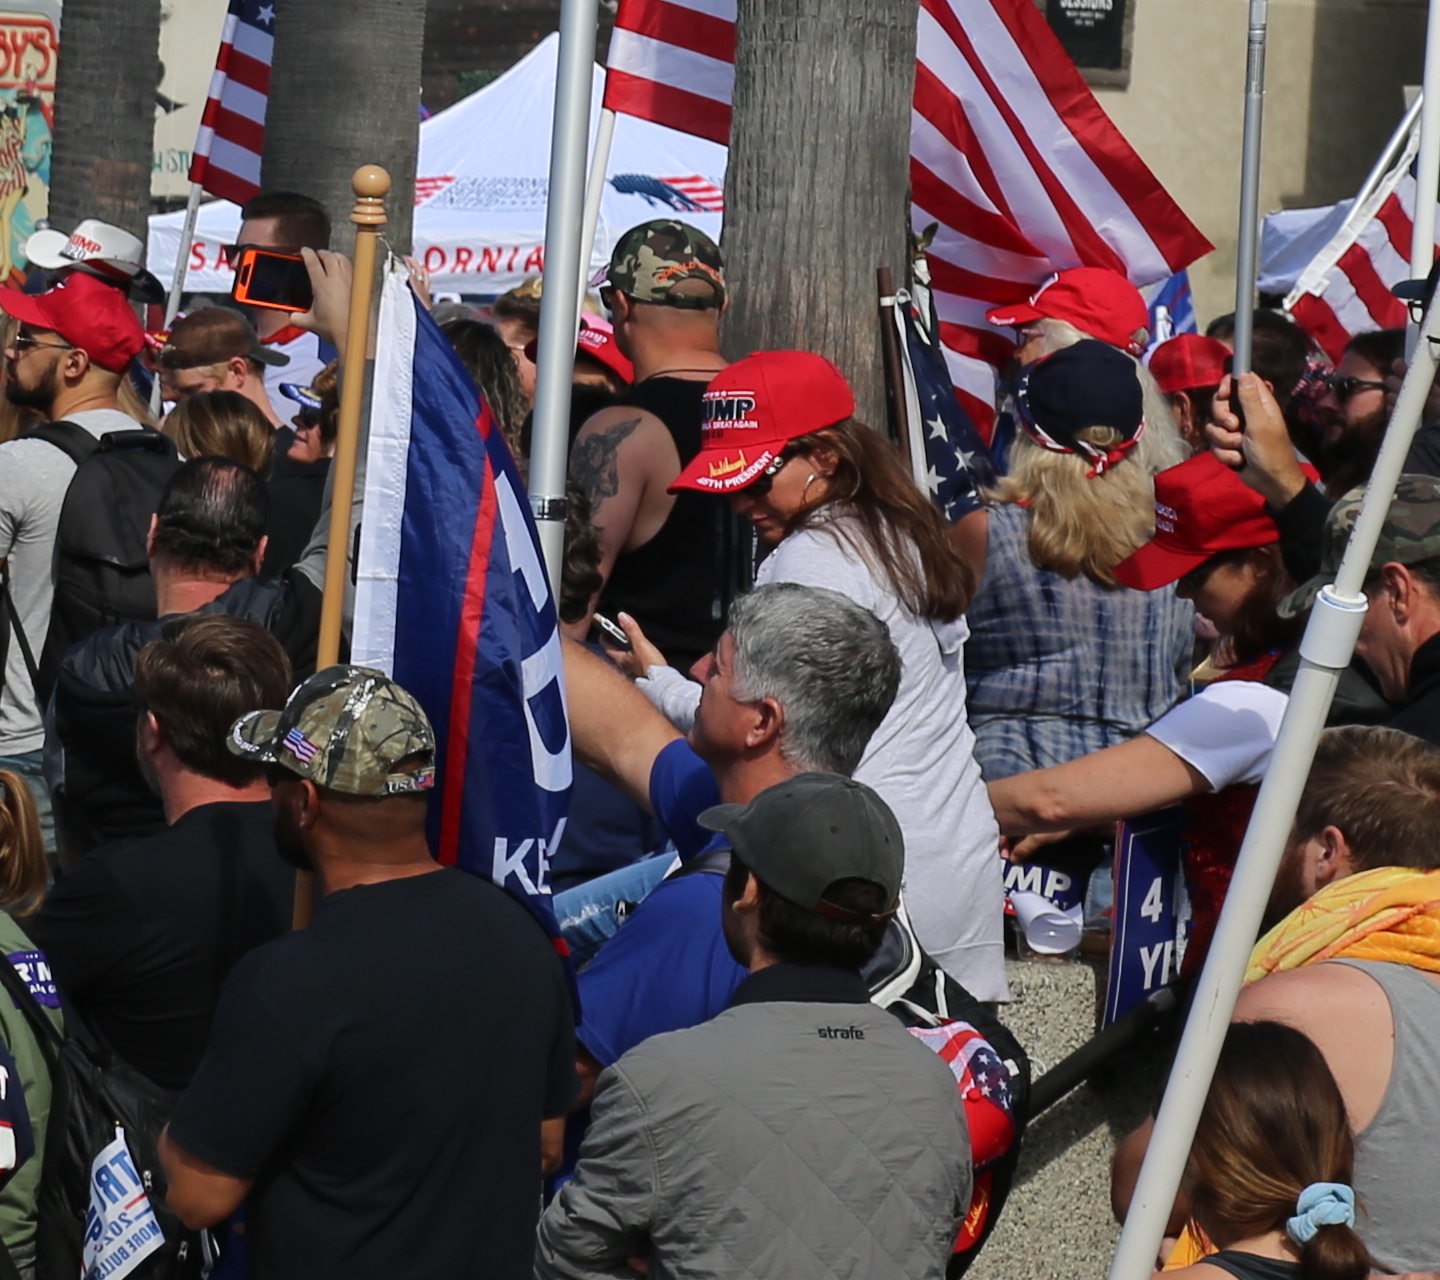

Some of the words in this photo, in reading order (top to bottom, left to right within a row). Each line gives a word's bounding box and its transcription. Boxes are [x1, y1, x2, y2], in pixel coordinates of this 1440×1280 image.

[424, 244, 546, 275] ORNIA
[696, 476, 723, 490] 45TH
[723, 450, 774, 489] PRESIDENT
[387, 780, 418, 794] USA
[1140, 876, 1163, 923] 4
[817, 1025, 865, 1041] strafe
